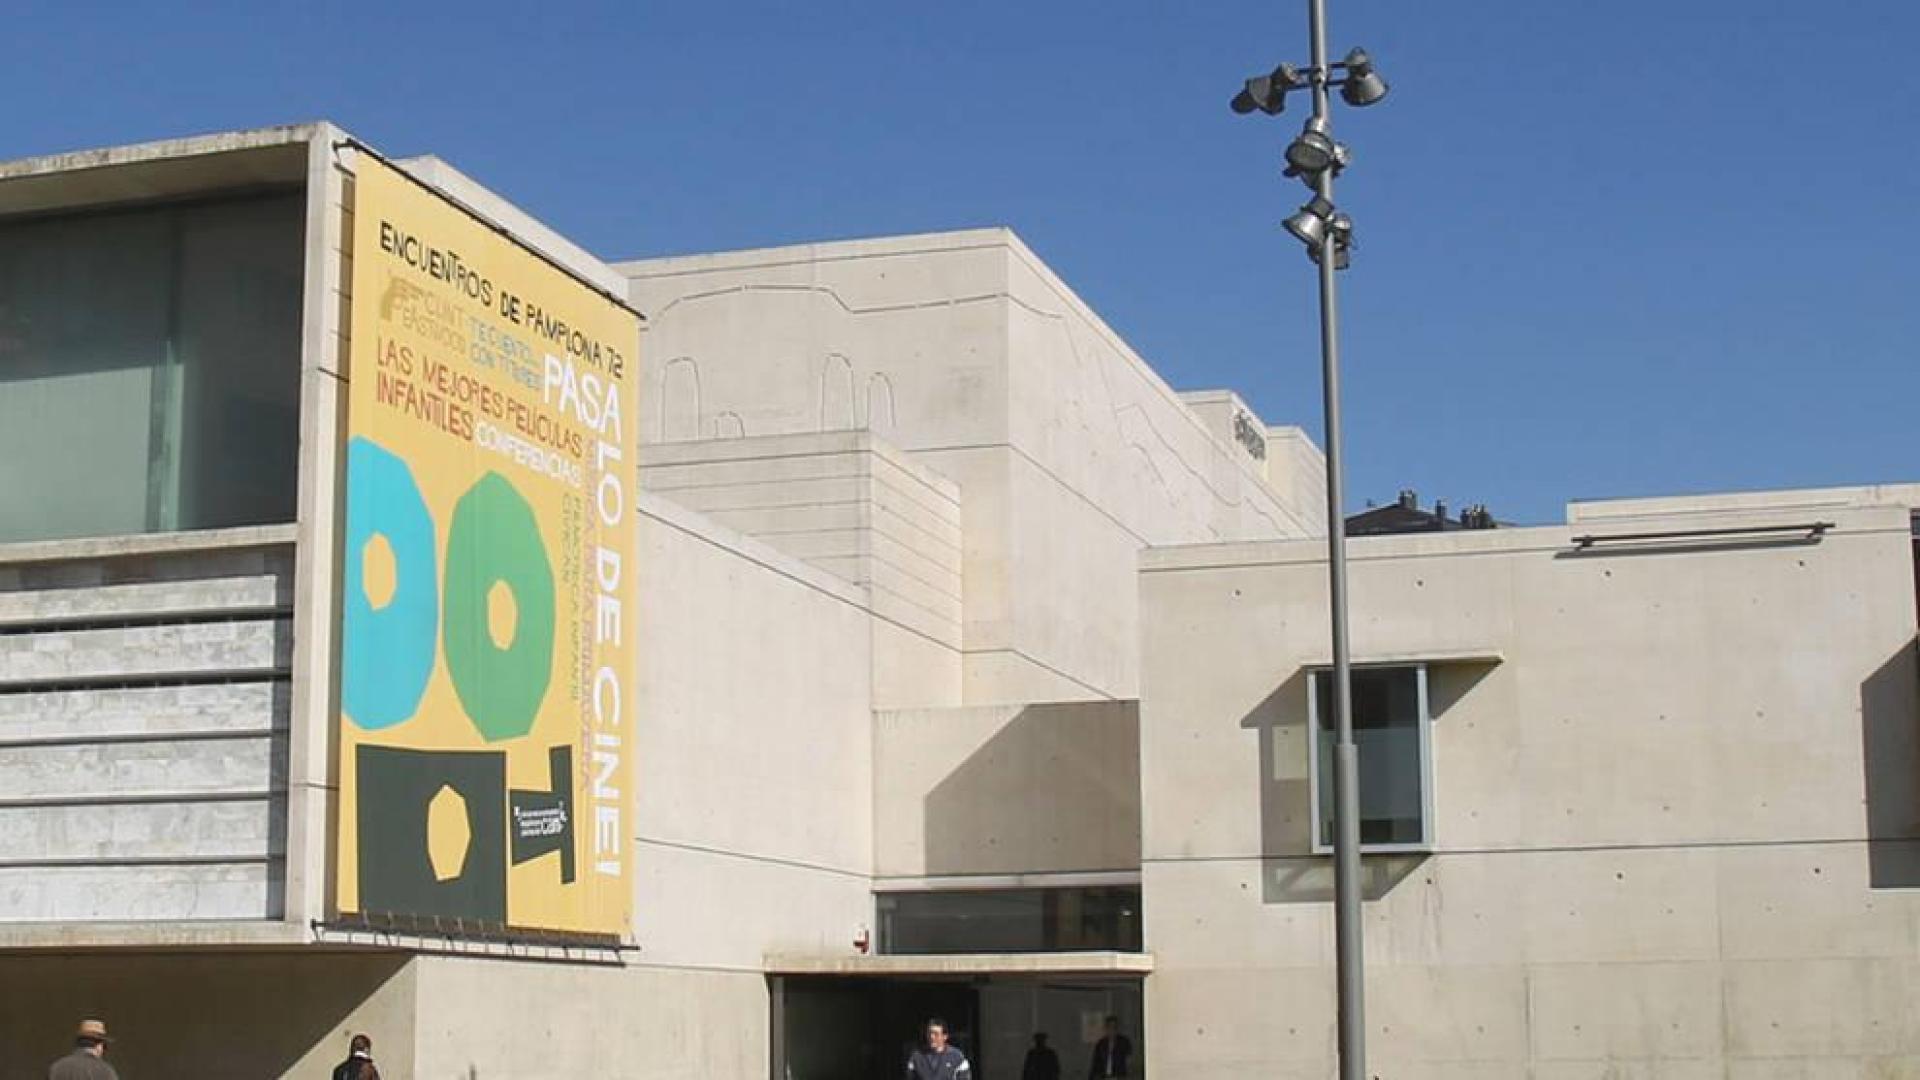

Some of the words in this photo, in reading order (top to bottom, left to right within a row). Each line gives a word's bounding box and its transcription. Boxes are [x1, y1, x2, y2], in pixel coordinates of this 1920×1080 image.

[380, 220, 493, 308] ENCUENTROS
[500, 291, 521, 325] DE
[526, 303, 602, 370] PAMPLONA
[604, 345, 623, 379] 72
[376, 371, 474, 442] INFANTILES
[474, 421, 582, 488] CONFERENCIAS
[377, 335, 415, 376] LAS
[422, 355, 510, 419] MEJORES
[596, 546, 621, 648] DE
